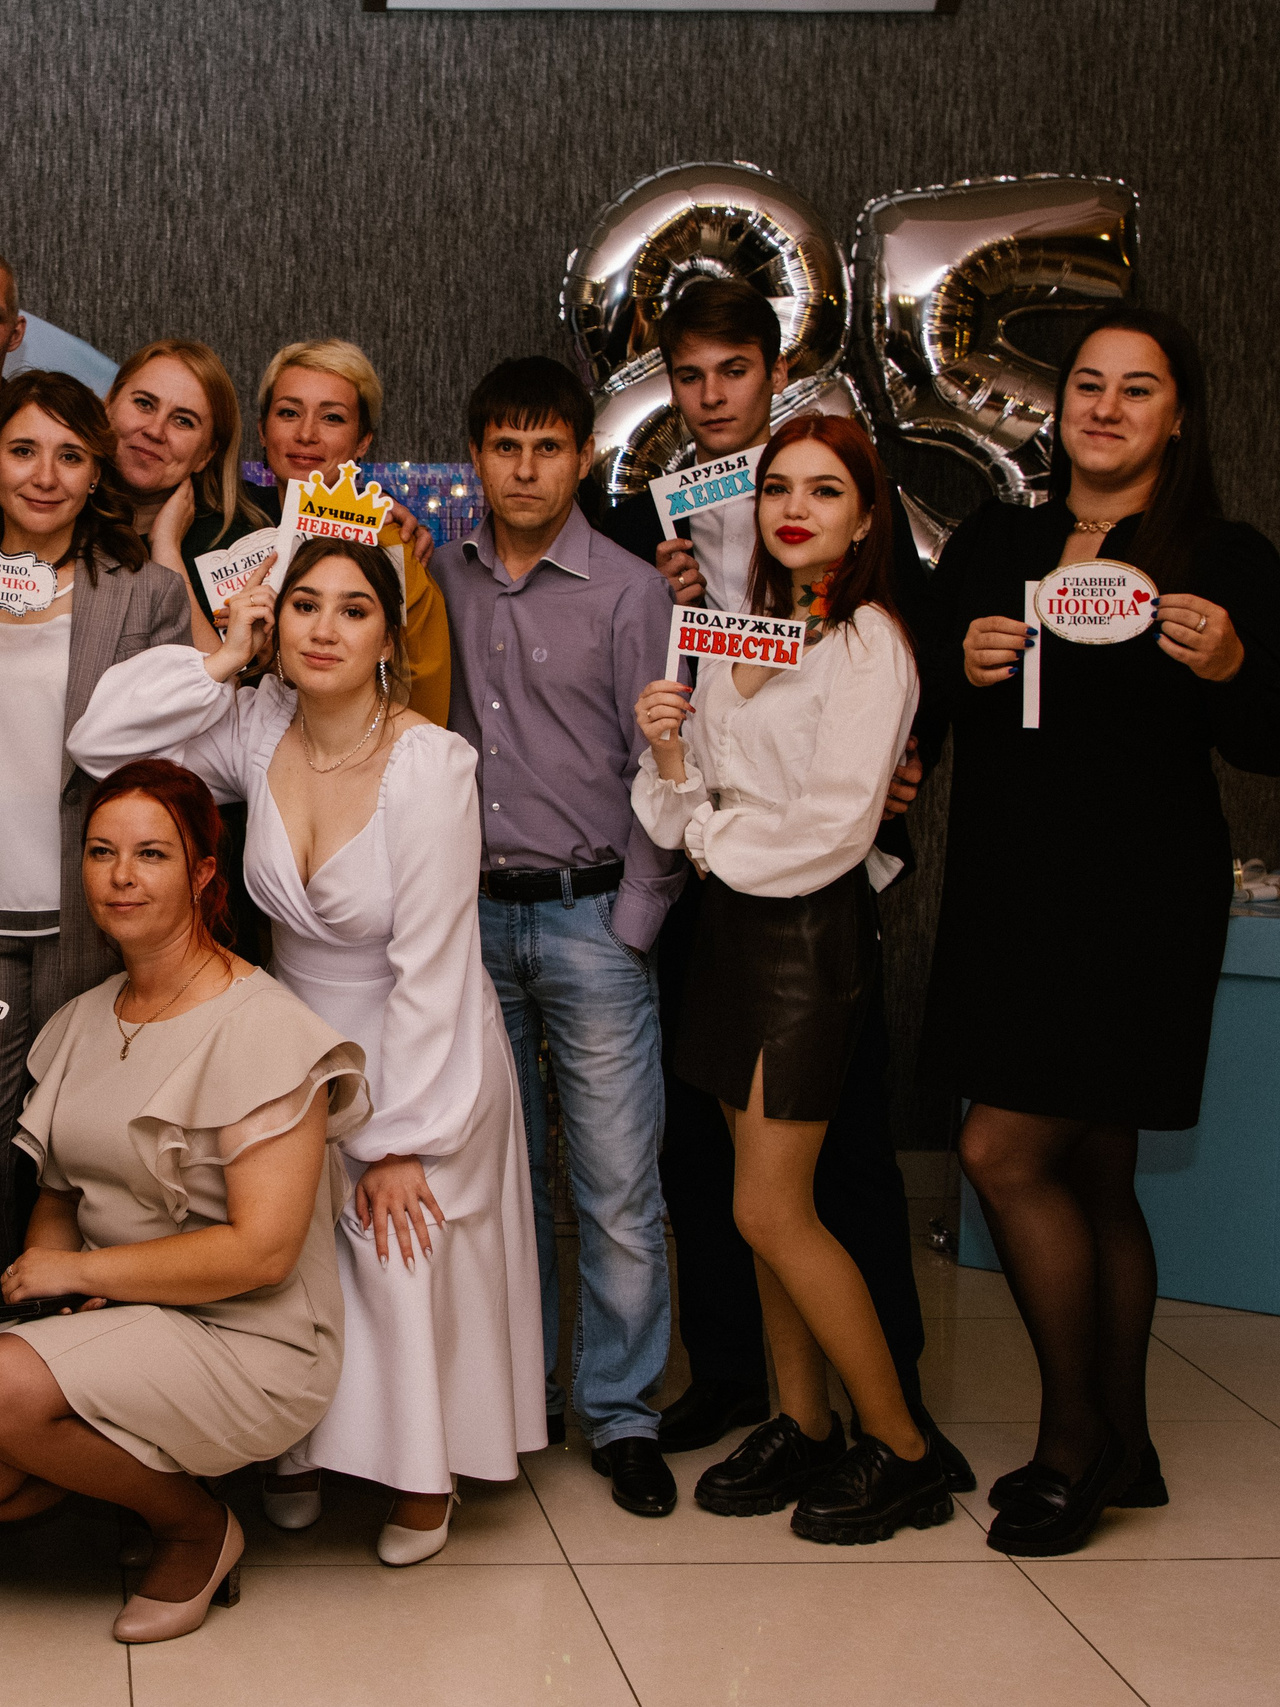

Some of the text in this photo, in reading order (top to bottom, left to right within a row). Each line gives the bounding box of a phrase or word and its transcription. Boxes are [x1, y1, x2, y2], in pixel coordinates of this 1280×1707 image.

[678, 455, 749, 488] ДРУЗЬЯ
[666, 469, 757, 516] ЖЕНИХ
[302, 500, 377, 526] Лучшая
[296, 516, 375, 545] НЕВЕСТА
[210, 562, 239, 583] МЫ
[1062, 576, 1127, 587] ГЛАВНЕЙ
[1072, 588, 1116, 597] ВСЕГО
[1047, 598, 1140, 620] ПОГОДА
[1056, 616, 1111, 626] В ДОМЕ!
[682, 610, 802, 639] ПОДРУЖКИ
[678, 627, 800, 665] НЕВЕСТЫ
